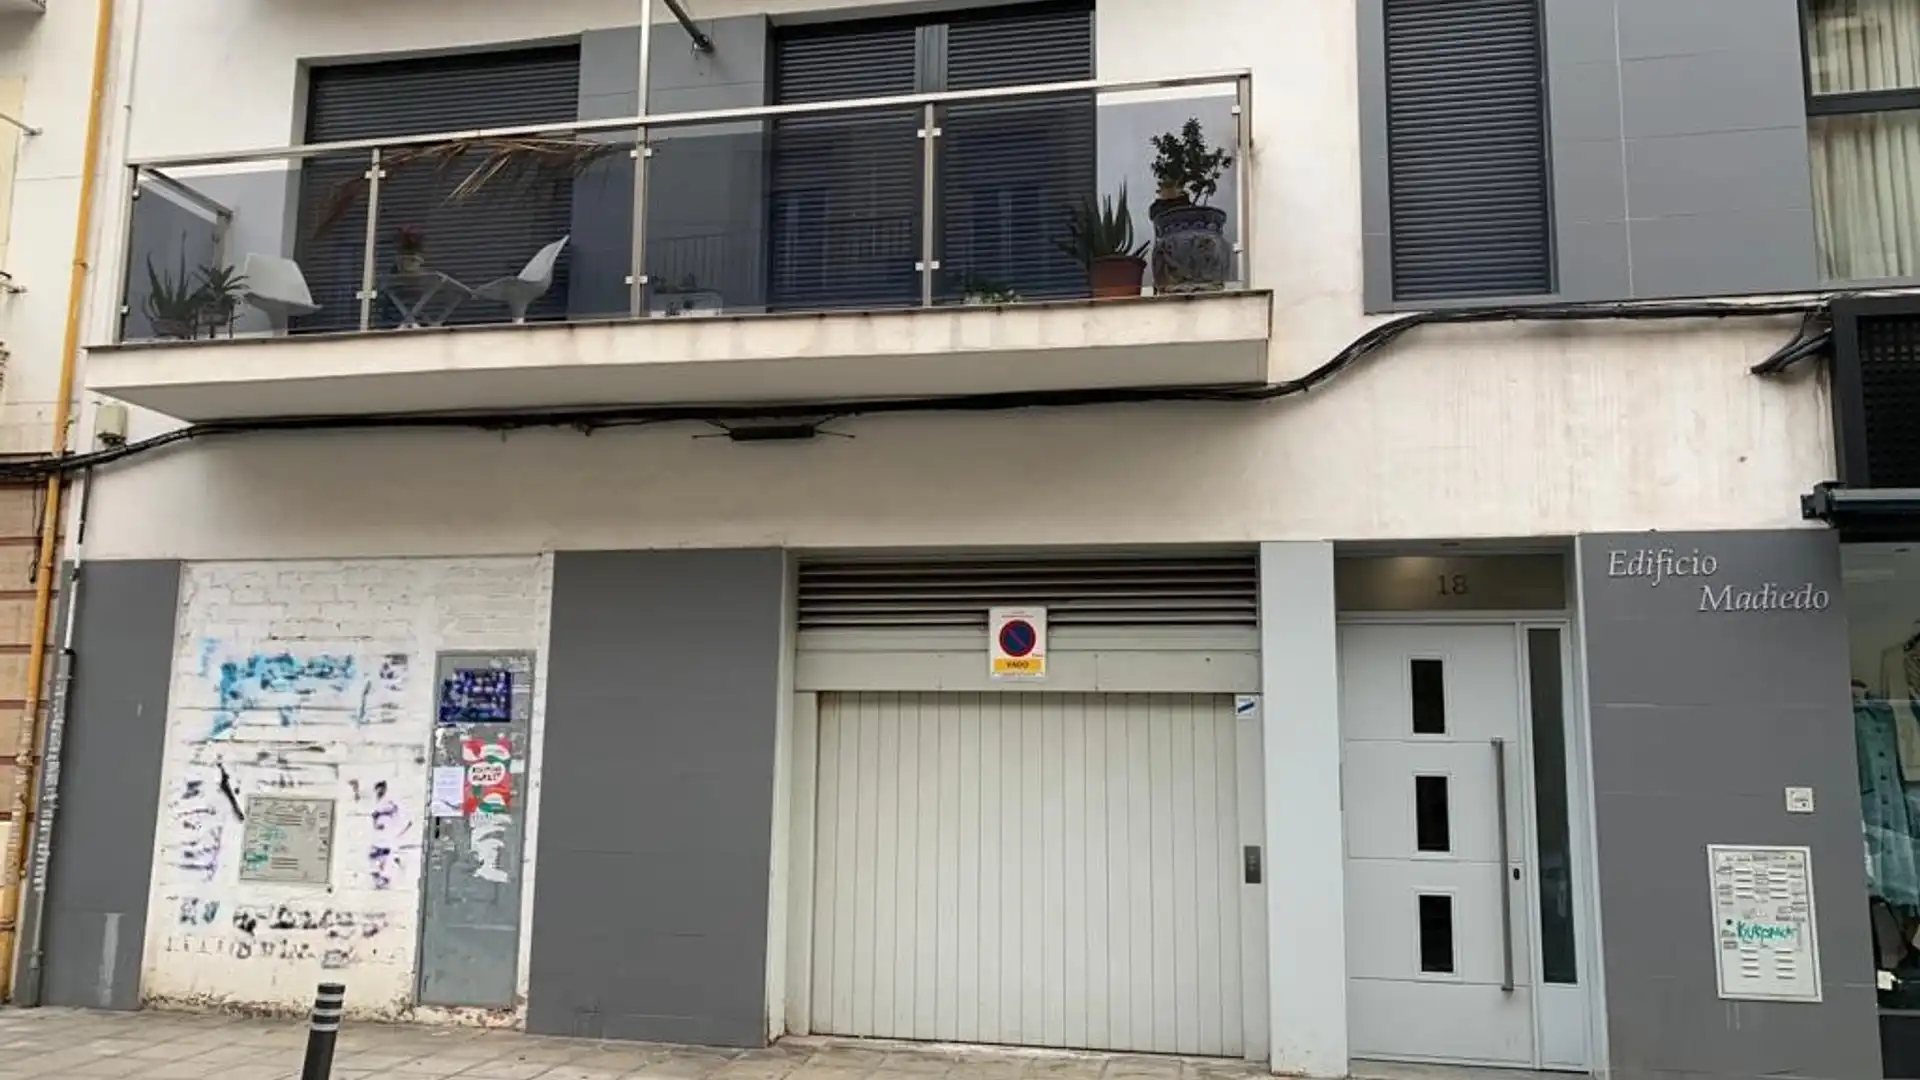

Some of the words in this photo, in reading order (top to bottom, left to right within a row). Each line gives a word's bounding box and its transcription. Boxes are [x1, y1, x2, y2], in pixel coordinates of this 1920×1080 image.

[1608, 549, 1718, 587] Edificio
[1437, 574, 1469, 596] 18
[1698, 582, 1830, 612] Madiedo
[1006, 660, 1030, 669] VADO
